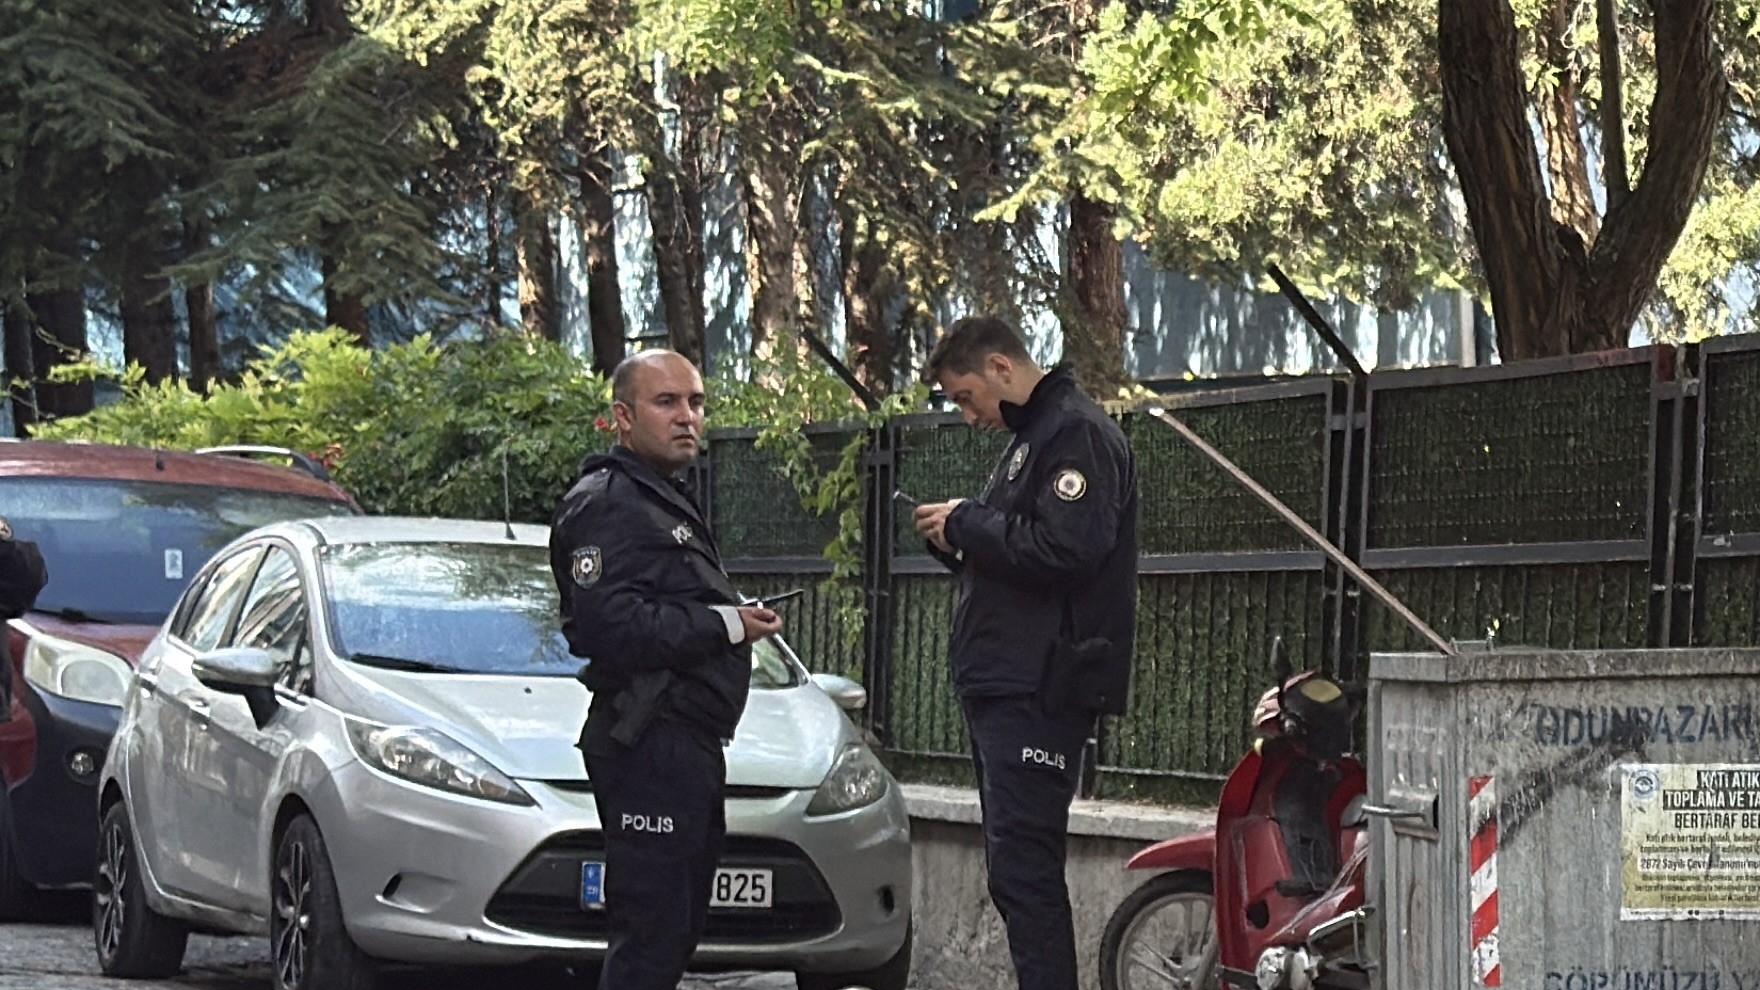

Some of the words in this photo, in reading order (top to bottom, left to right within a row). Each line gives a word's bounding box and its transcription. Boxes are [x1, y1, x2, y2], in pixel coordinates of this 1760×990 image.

[1732, 770, 1760, 788] ATIK
[1665, 790, 1725, 808] TOPLAMA
[1729, 791, 1745, 808] VE
[1674, 812, 1736, 829] BERTARAF
[717, 873, 766, 904] 825
